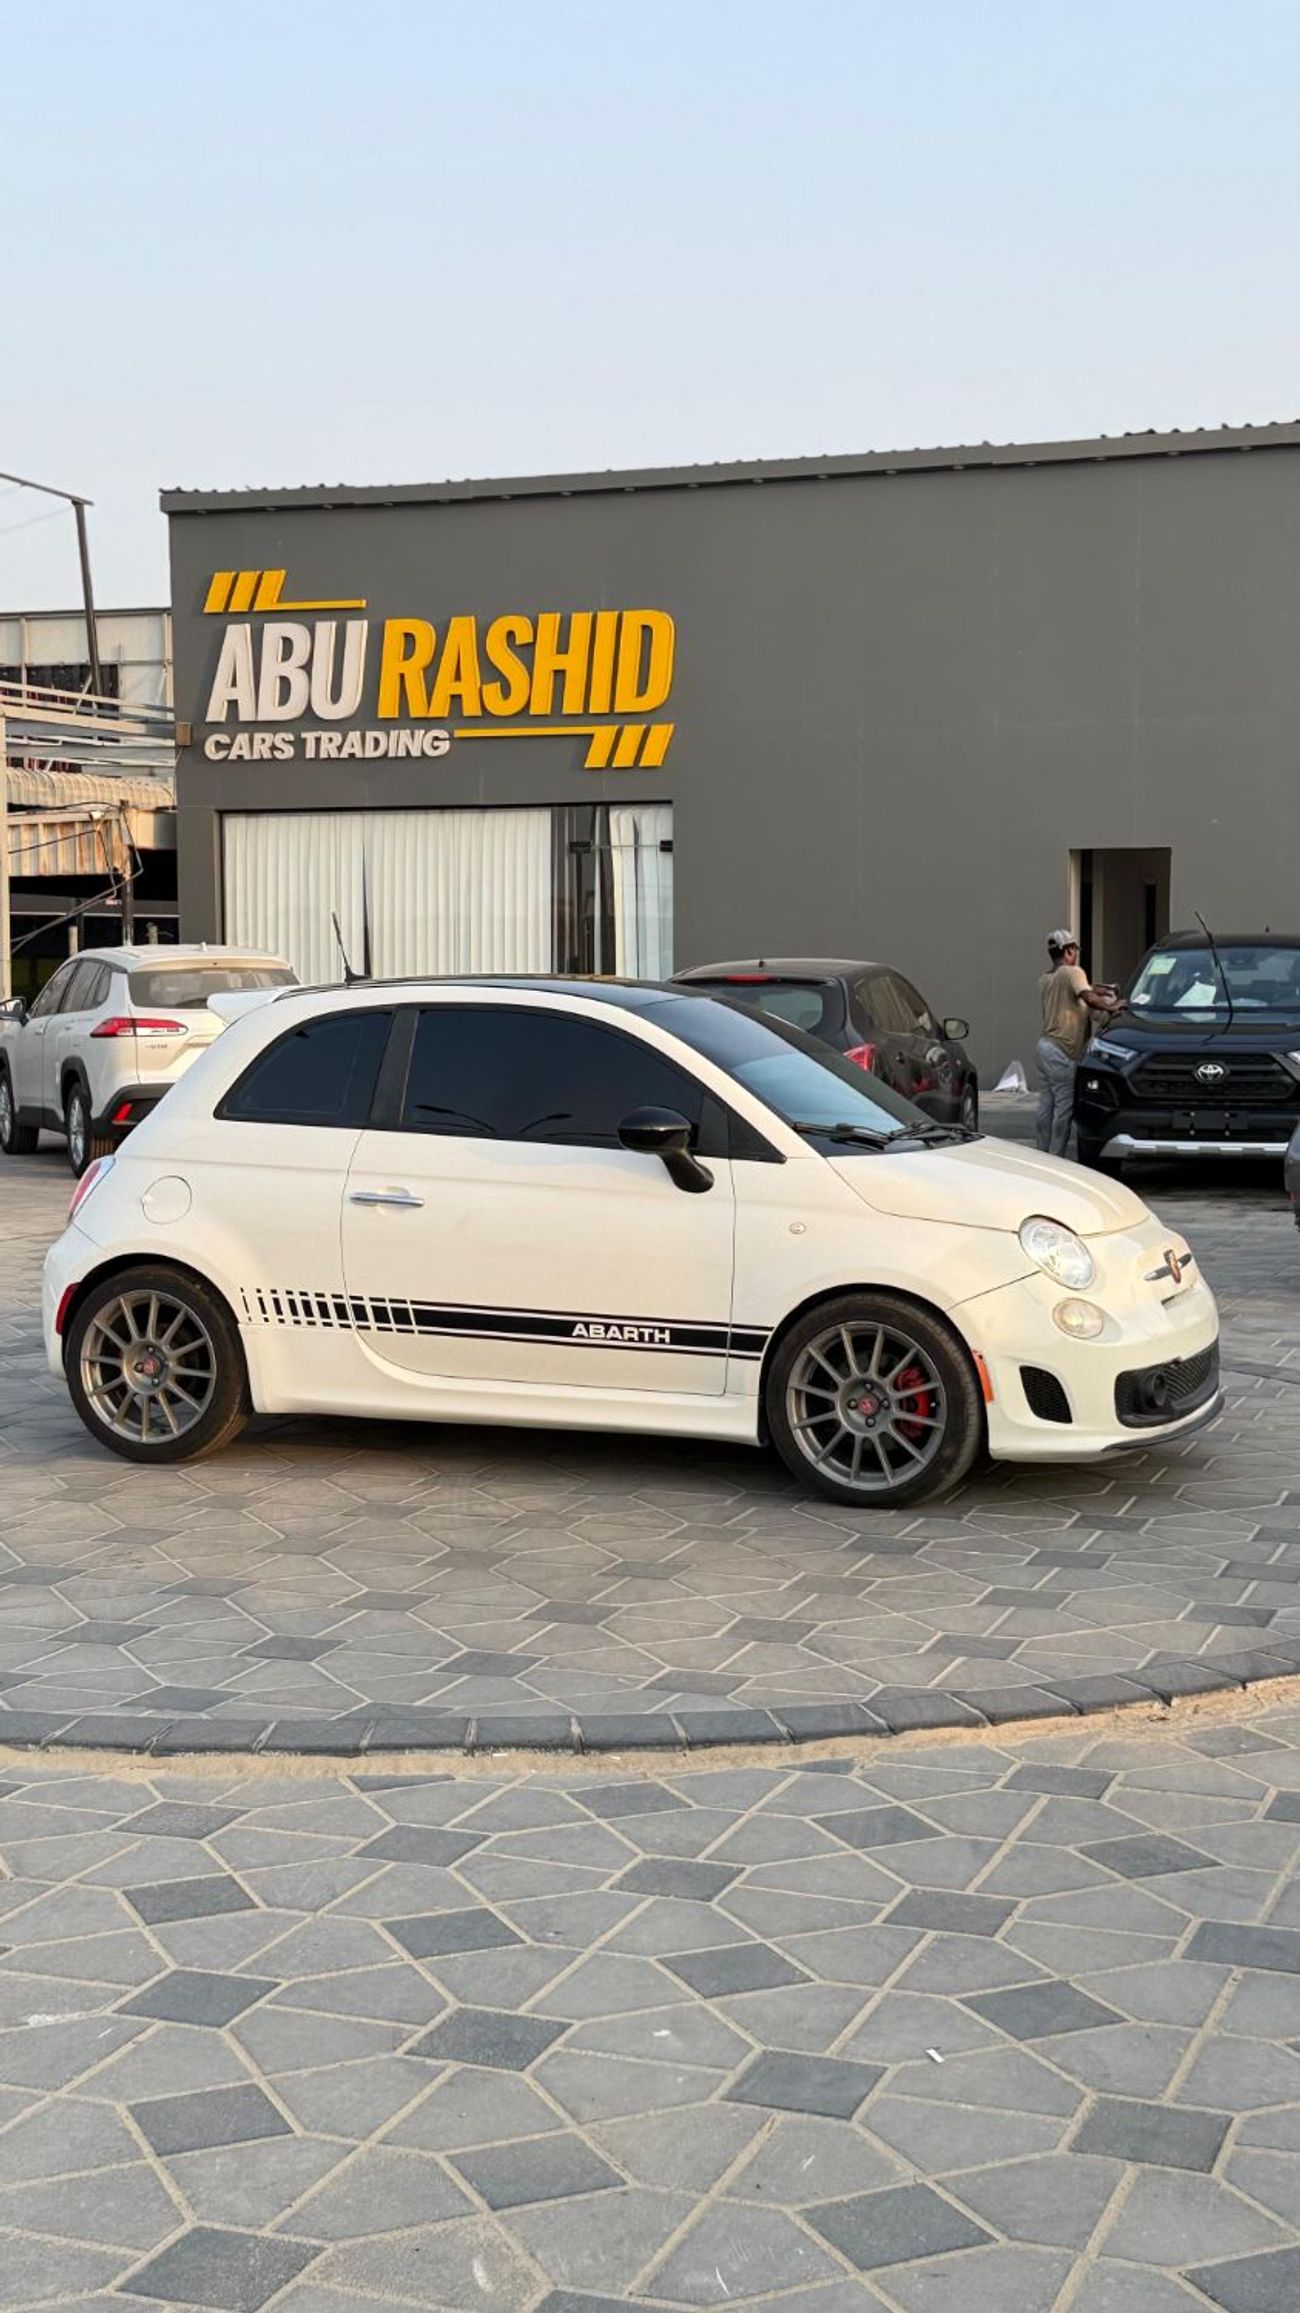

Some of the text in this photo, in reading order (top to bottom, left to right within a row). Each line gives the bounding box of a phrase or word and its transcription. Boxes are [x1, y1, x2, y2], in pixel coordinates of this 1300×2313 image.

[205, 609, 675, 722] ABU RASHID
[204, 729, 450, 760] CARS TRADING
[572, 1323, 671, 1344] ABARTH
